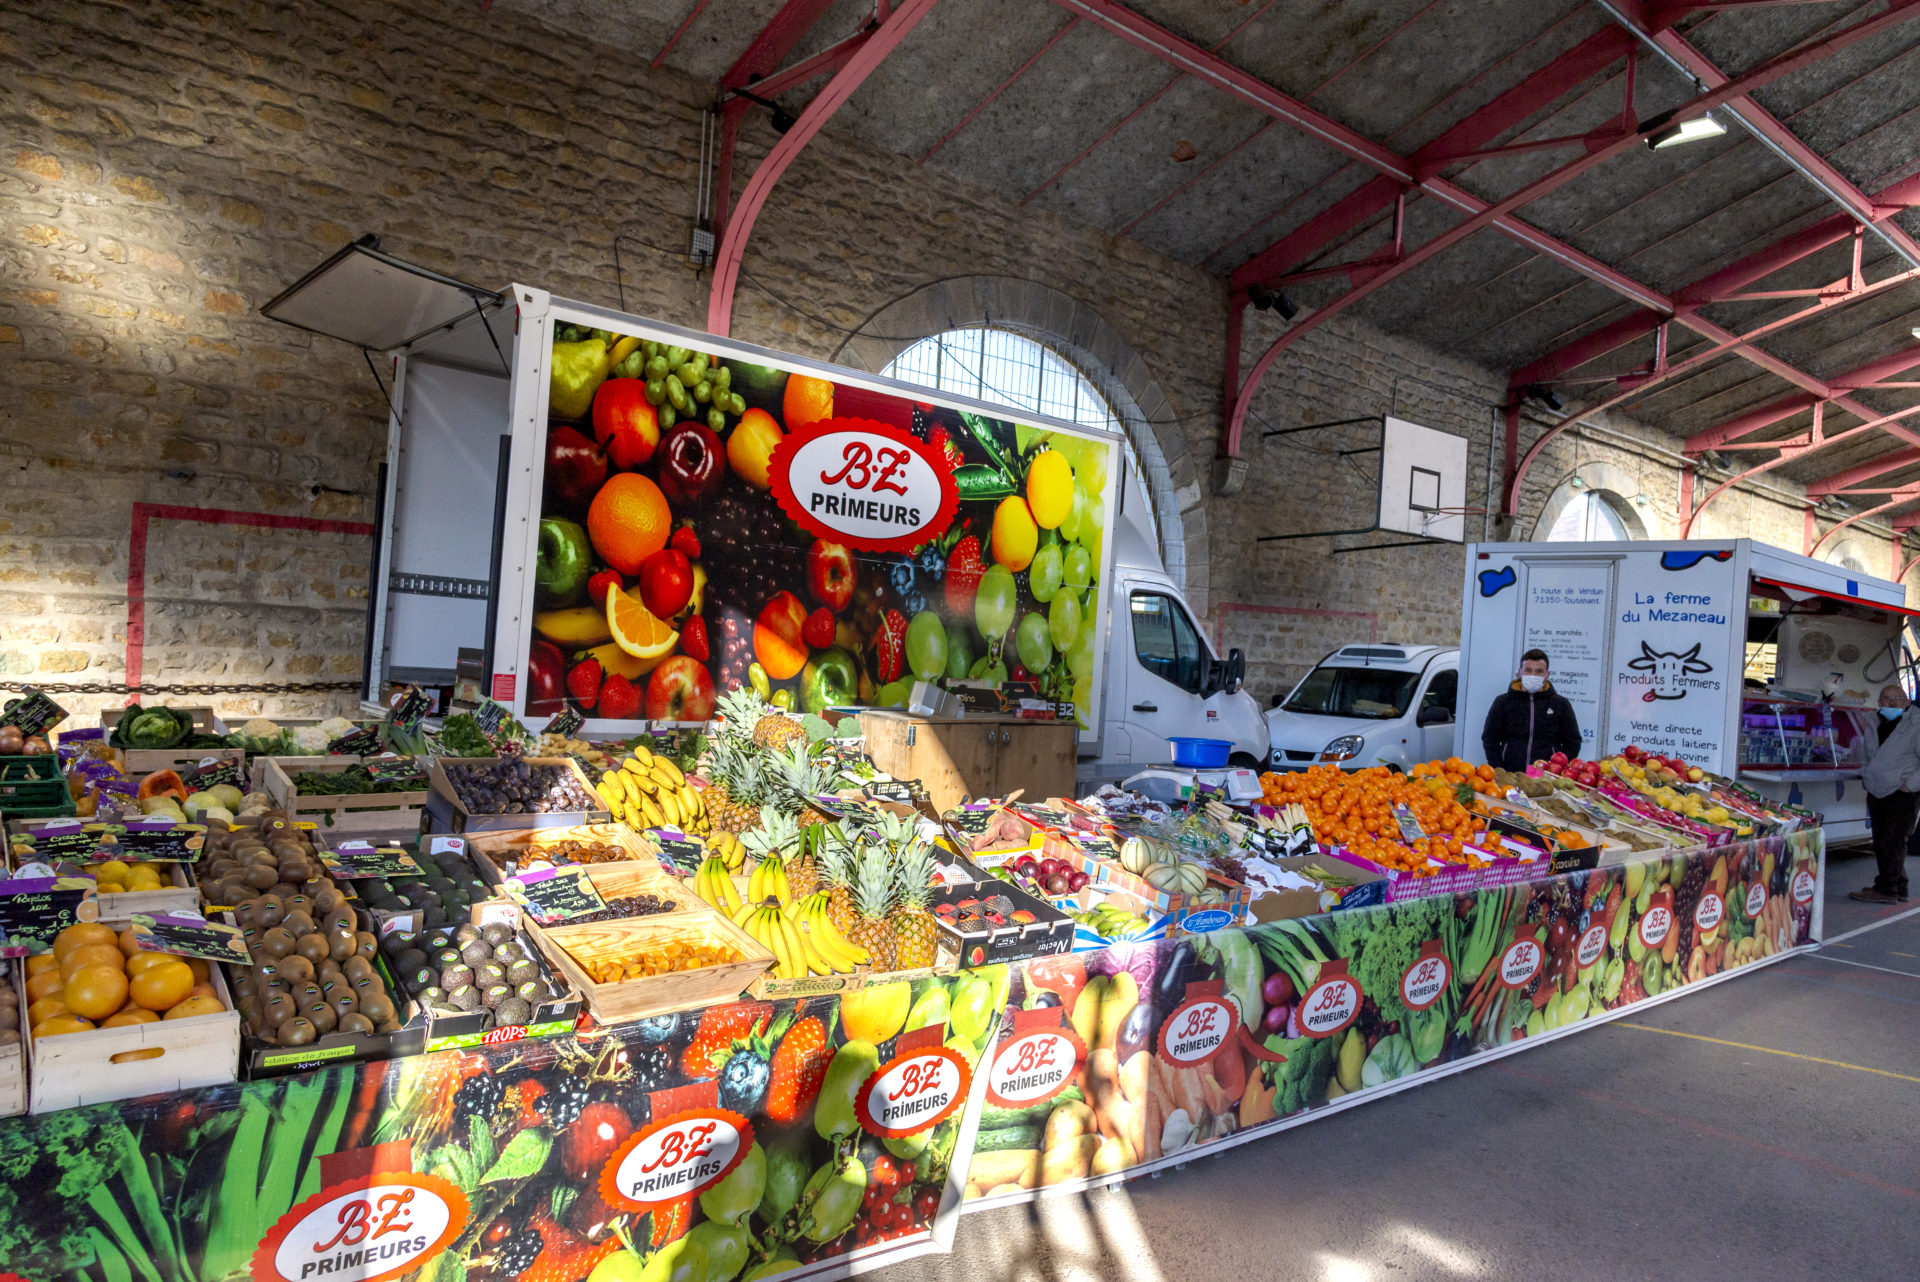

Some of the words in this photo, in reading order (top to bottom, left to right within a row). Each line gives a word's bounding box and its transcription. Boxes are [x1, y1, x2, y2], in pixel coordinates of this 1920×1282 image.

[1578, 588, 1604, 596] Verdun
[1635, 592, 1654, 604] La
[1664, 592, 1711, 605] ferme
[1622, 610, 1640, 622] du
[1648, 608, 1726, 624] Mezaneau
[1618, 672, 1665, 684] Produits
[1672, 674, 1720, 690] Fermiers
[1630, 720, 1659, 732] Vente
[1665, 724, 1703, 735] directe
[1614, 732, 1626, 741] de
[1632, 735, 1676, 746] produits
[1682, 738, 1718, 750] laitiers
[1676, 750, 1710, 762] bovine
[1038, 938, 1068, 955] Nectar
[484, 1026, 526, 1044] TROPS
